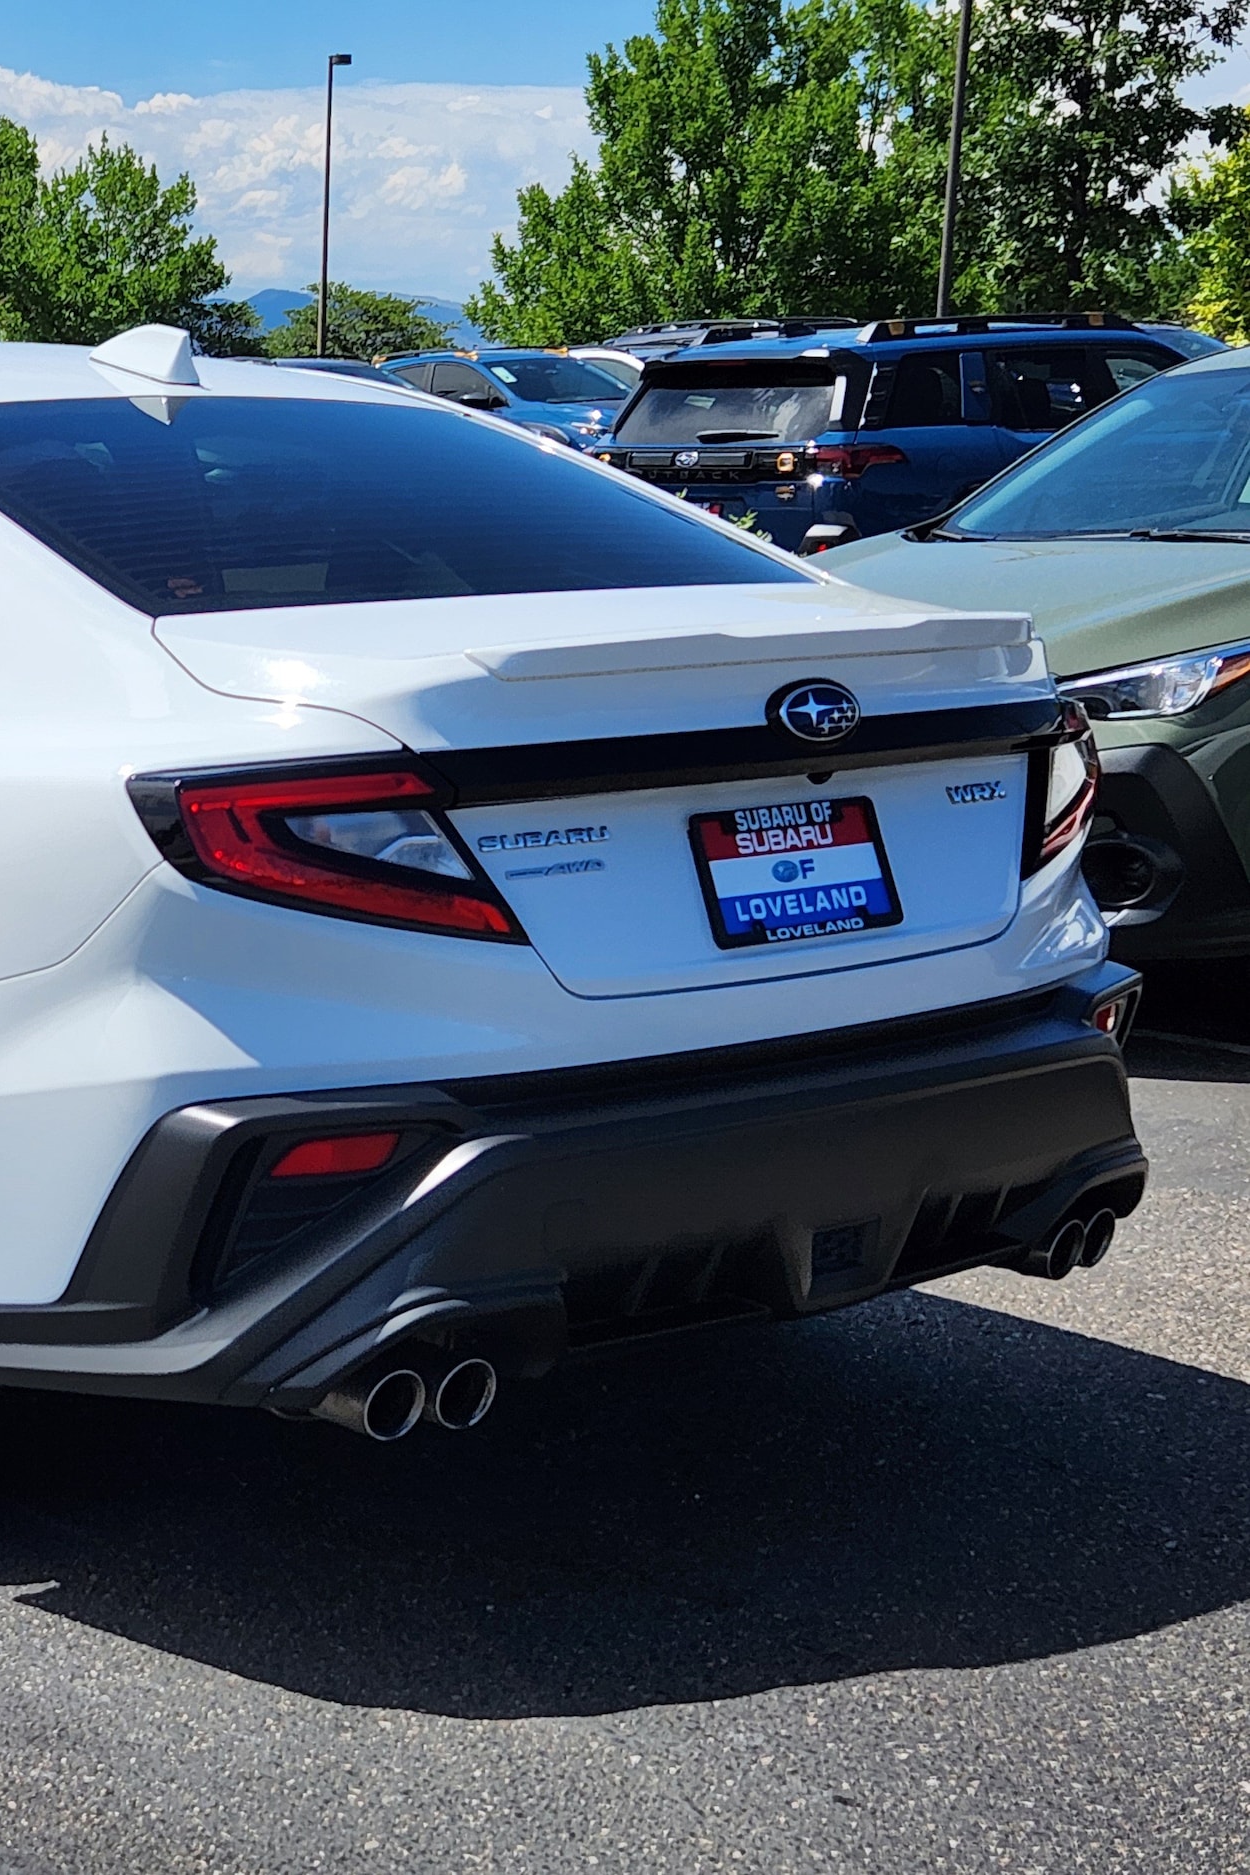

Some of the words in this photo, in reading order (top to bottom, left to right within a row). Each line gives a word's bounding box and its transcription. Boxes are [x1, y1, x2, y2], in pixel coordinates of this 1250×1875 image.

[945, 780, 1007, 804] WRX
[734, 804, 807, 832] SUBARU
[811, 801, 833, 824] OF
[477, 825, 610, 852] SUBARU
[735, 823, 833, 855] SUBARU
[735, 885, 867, 922] LOVELAND
[765, 917, 865, 942] LOVELAND
